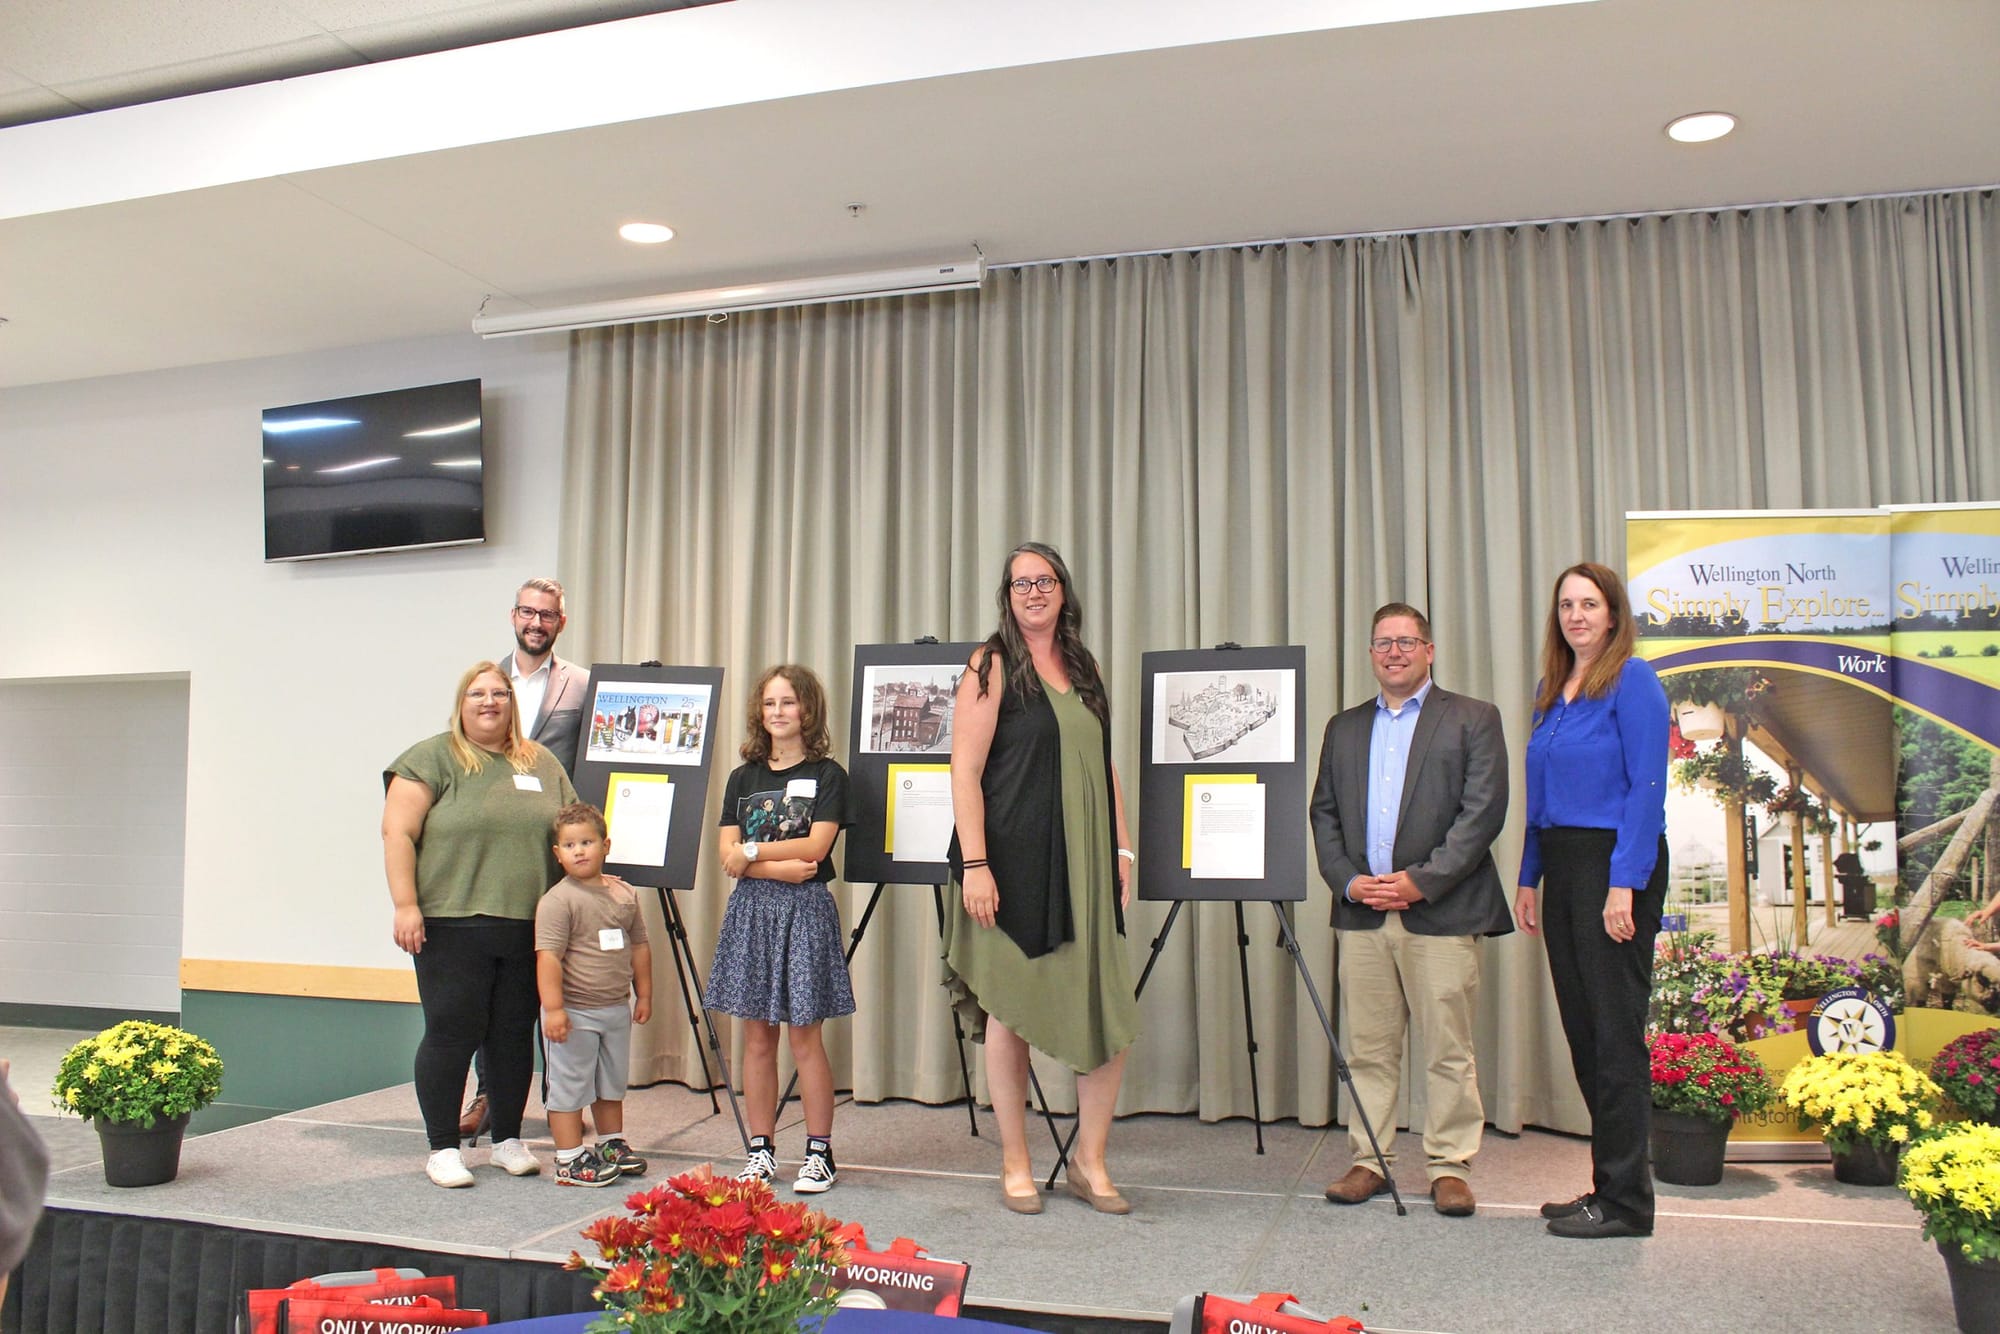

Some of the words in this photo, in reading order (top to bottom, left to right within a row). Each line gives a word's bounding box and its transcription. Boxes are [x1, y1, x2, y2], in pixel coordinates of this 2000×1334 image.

[1689, 563, 1780, 585] Wellington
[1785, 563, 1836, 585] North
[1646, 587, 1750, 626] Simply
[1895, 580, 2000, 619] Simply
[1838, 655, 1886, 673] Work
[598, 694, 668, 706] WELLINGTON
[590, 704, 703, 747] NORTH
[1810, 990, 1857, 1017] WELLINGTON
[847, 1264, 934, 1291] WORKING
[320, 1318, 374, 1334] ONLY
